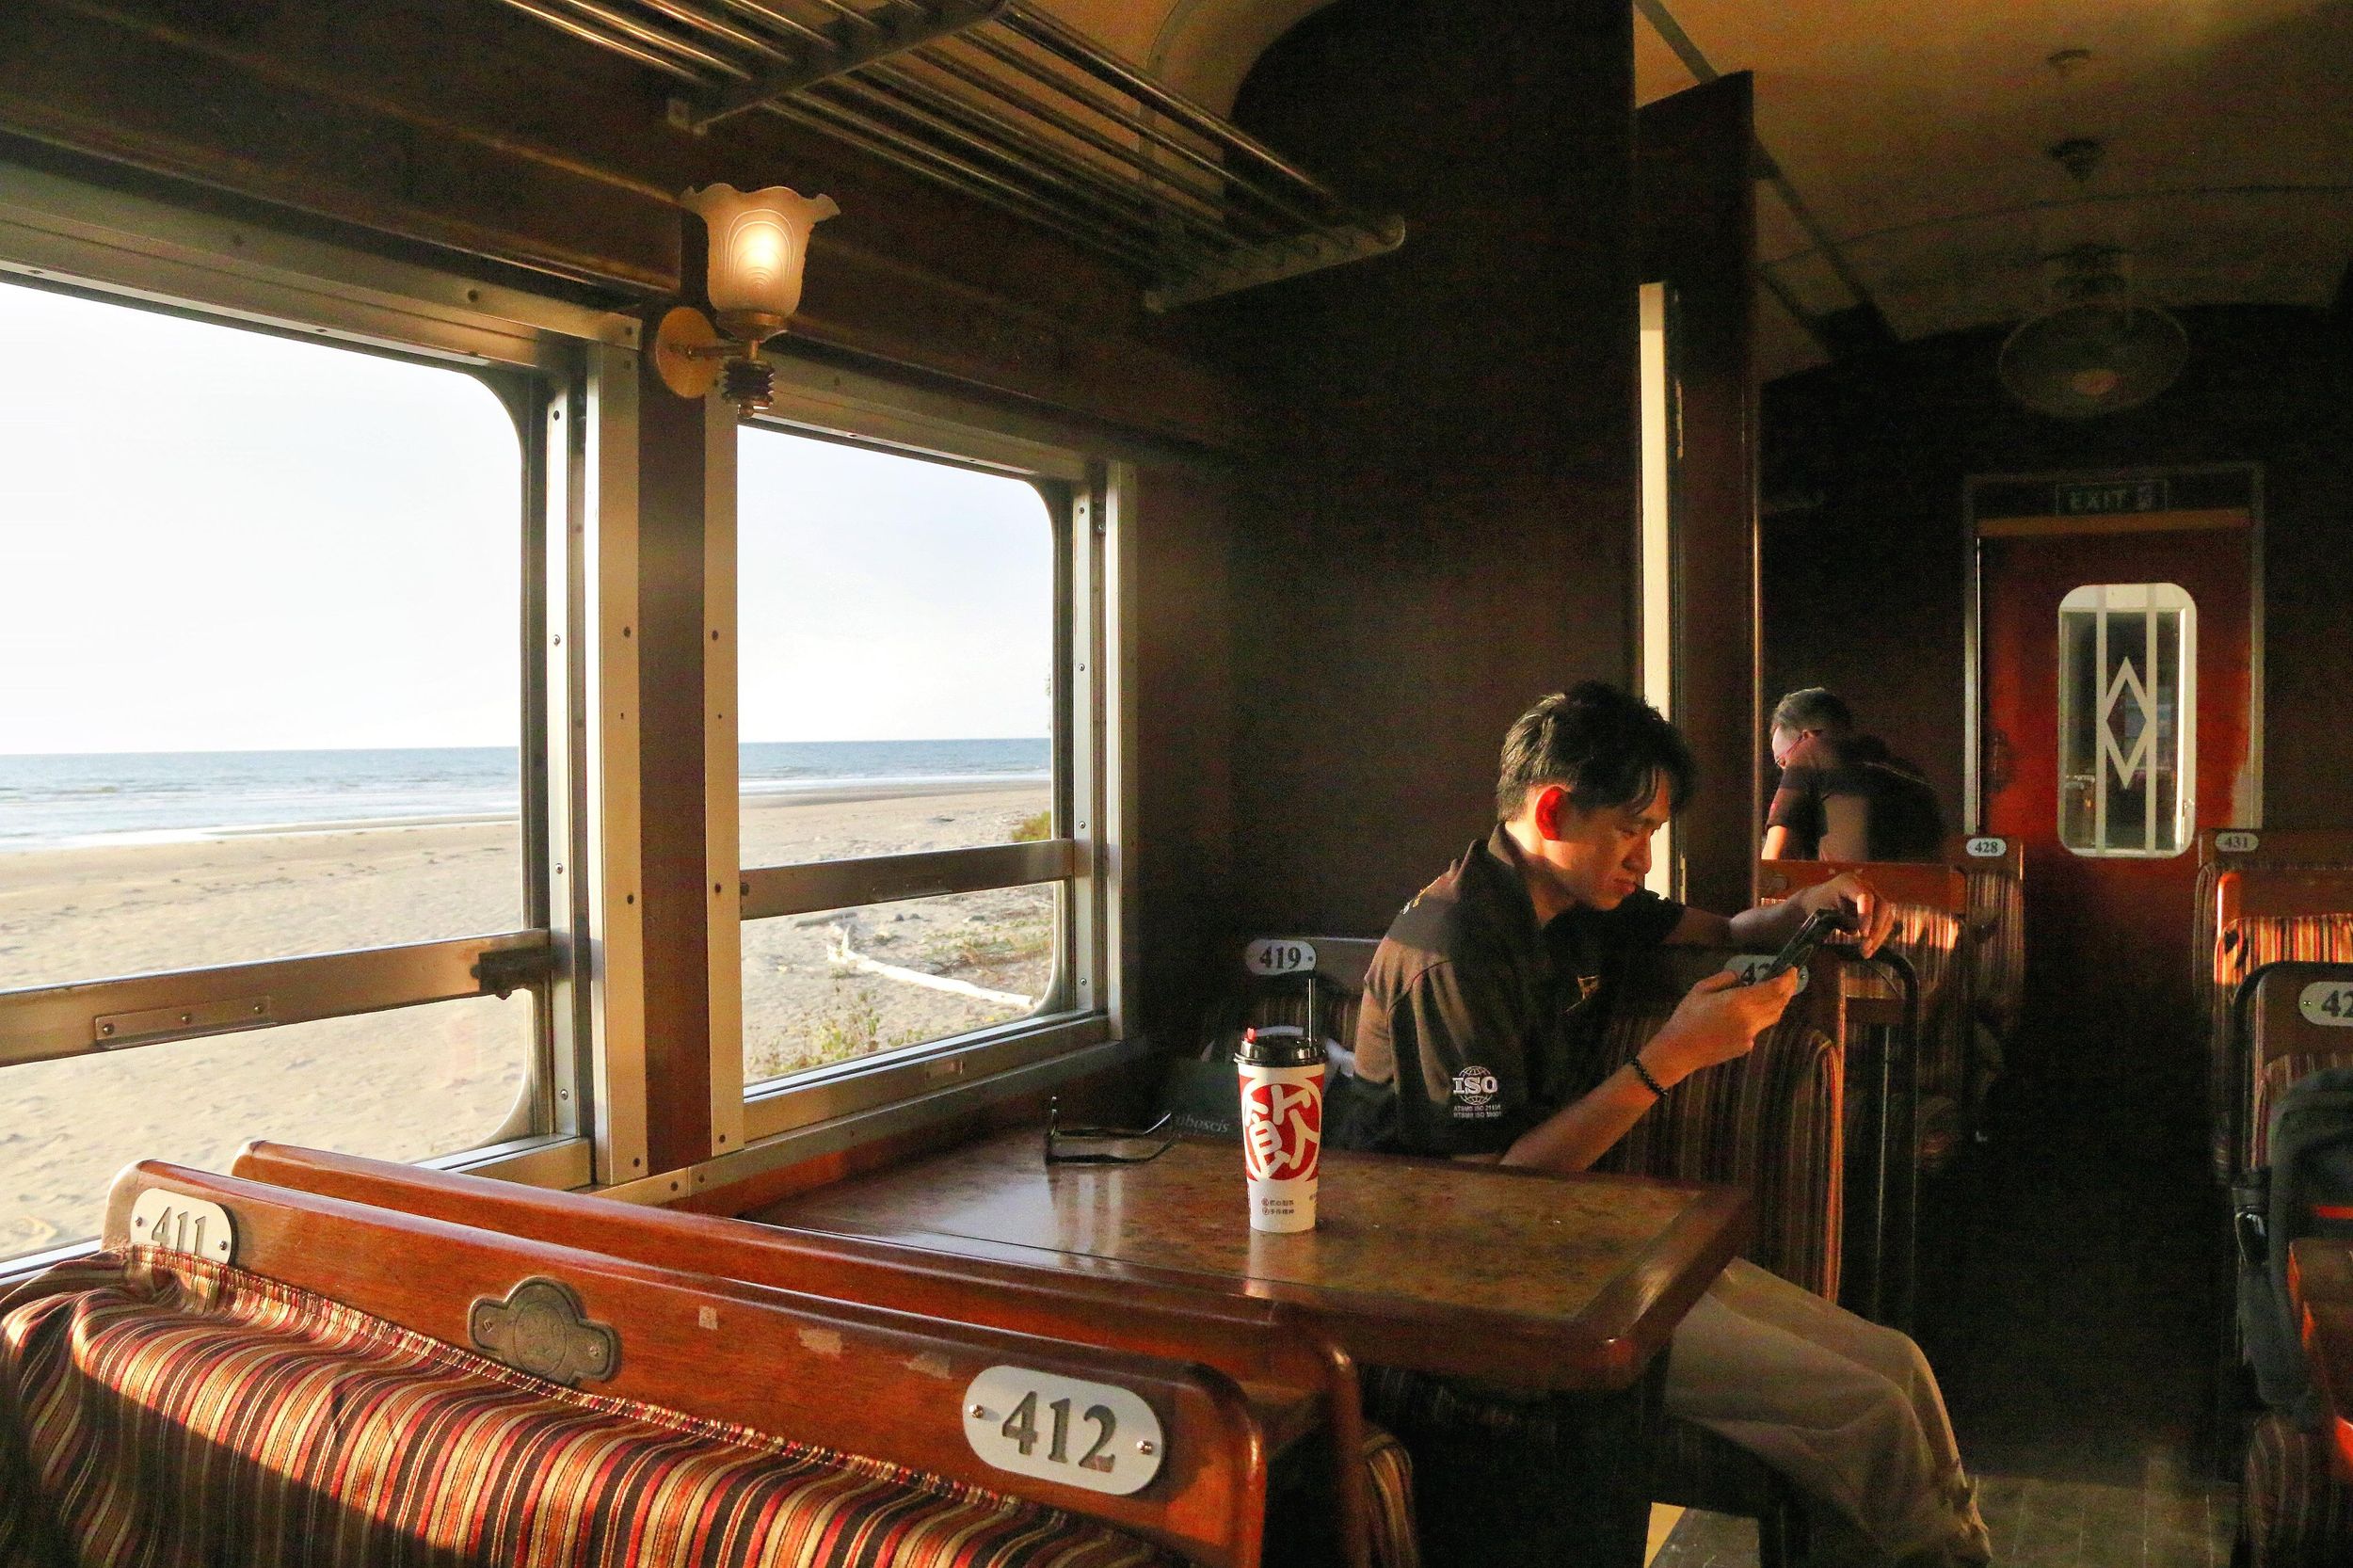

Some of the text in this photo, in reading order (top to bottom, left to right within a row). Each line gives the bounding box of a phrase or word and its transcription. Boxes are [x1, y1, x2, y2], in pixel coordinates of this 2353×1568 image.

[2070, 488, 2127, 511] EXIT
[1975, 840, 1998, 853] 428
[1259, 946, 1302, 969] 419
[1452, 1076, 1498, 1095] ISO
[152, 1206, 206, 1256] 411
[1001, 1390, 1116, 1473] 412
